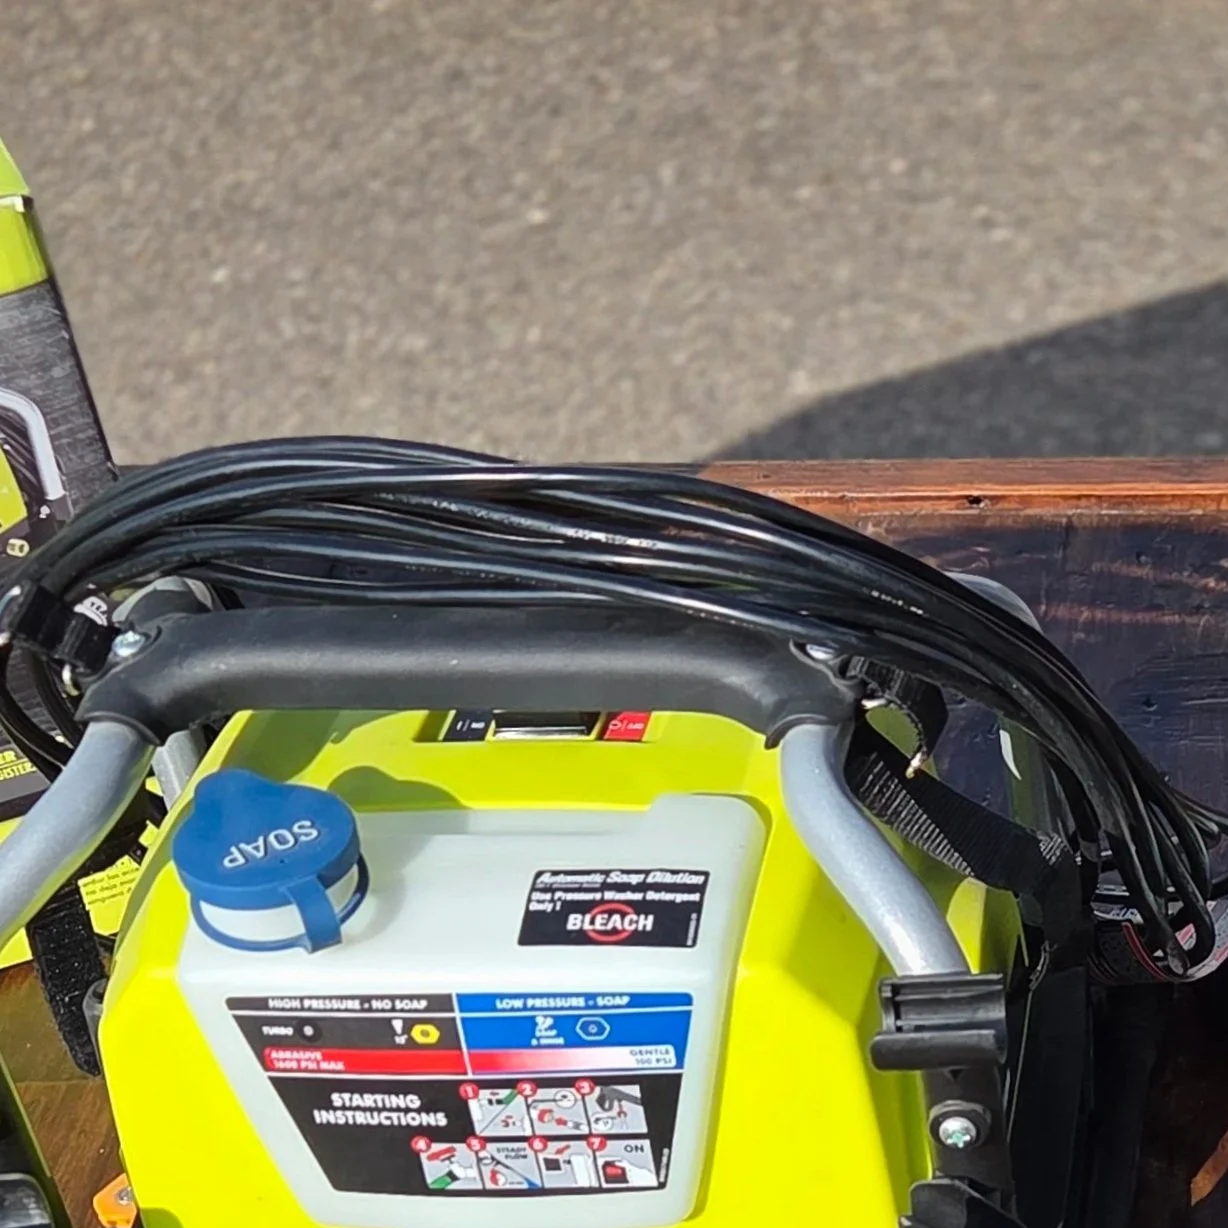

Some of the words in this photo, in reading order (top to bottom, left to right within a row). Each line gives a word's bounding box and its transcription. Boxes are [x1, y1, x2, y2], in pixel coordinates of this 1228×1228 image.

[223, 820, 318, 868] SOAP
[536, 872, 606, 884] Automatic
[606, 871, 645, 885] Soap
[646, 871, 705, 884] Dilution
[531, 891, 551, 901] Use
[554, 891, 601, 901] Pressure
[604, 891, 644, 901] Washer
[646, 891, 701, 903] Detergent
[528, 900, 554, 912] Only
[566, 914, 654, 931] BLEACH
[268, 998, 301, 1009] HIGH
[303, 998, 361, 1010] PRESSURE
[371, 1000, 392, 1010] NO
[395, 1000, 428, 1010] SOAP
[496, 999, 524, 1009] LOW
[526, 997, 586, 1008] PRESSURE
[597, 996, 630, 1006] SOAP
[262, 1026, 294, 1036] TURBO
[271, 1051, 322, 1060] ABRASIVE
[630, 1048, 671, 1057] GENTLE
[301, 1060, 317, 1070] PSI
[319, 1061, 345, 1070] MAX
[331, 1092, 421, 1108] STARTING
[313, 1109, 448, 1126] INSTRUCTIONS
[624, 1144, 644, 1153] ON
